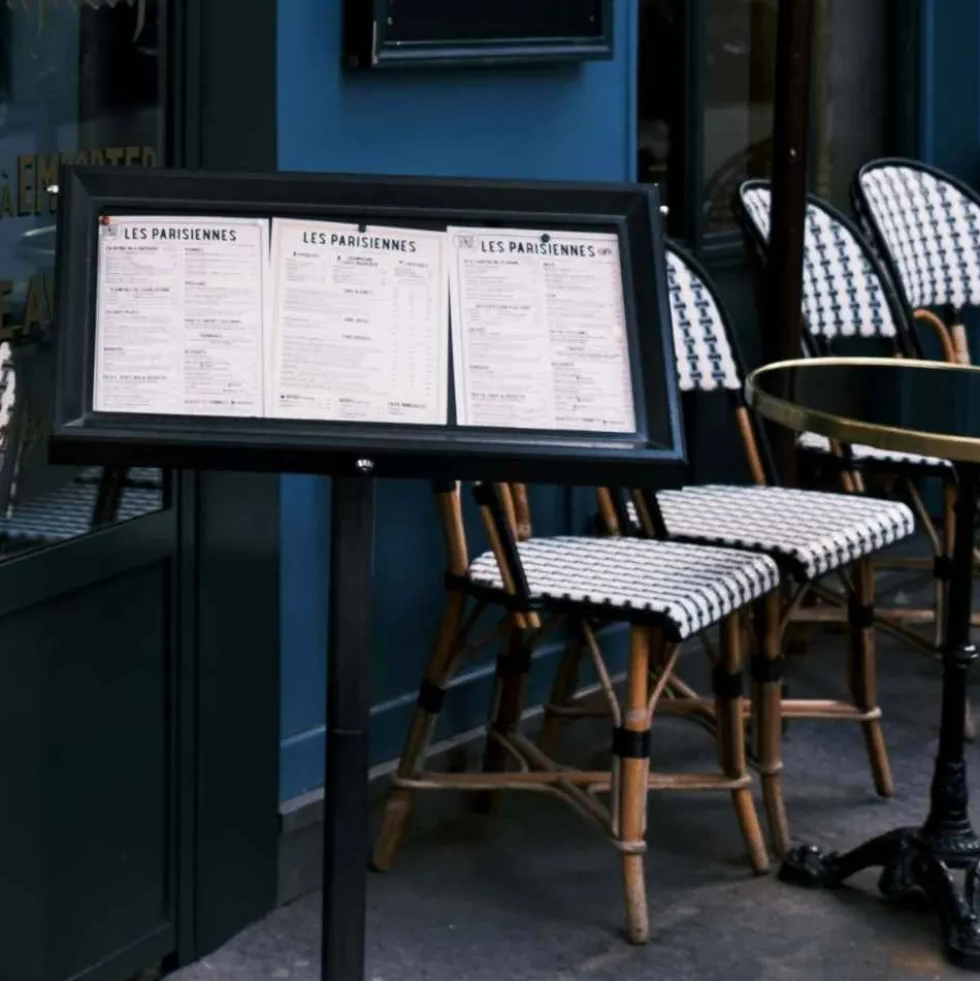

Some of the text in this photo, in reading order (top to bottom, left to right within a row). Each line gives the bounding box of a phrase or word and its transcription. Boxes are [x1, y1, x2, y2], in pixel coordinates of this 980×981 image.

[124, 227, 237, 242] LES PARISIENNES
[303, 231, 417, 253] LES PARISIENNES
[480, 240, 505, 253] LES
[509, 241, 596, 258] PARISIENNES
